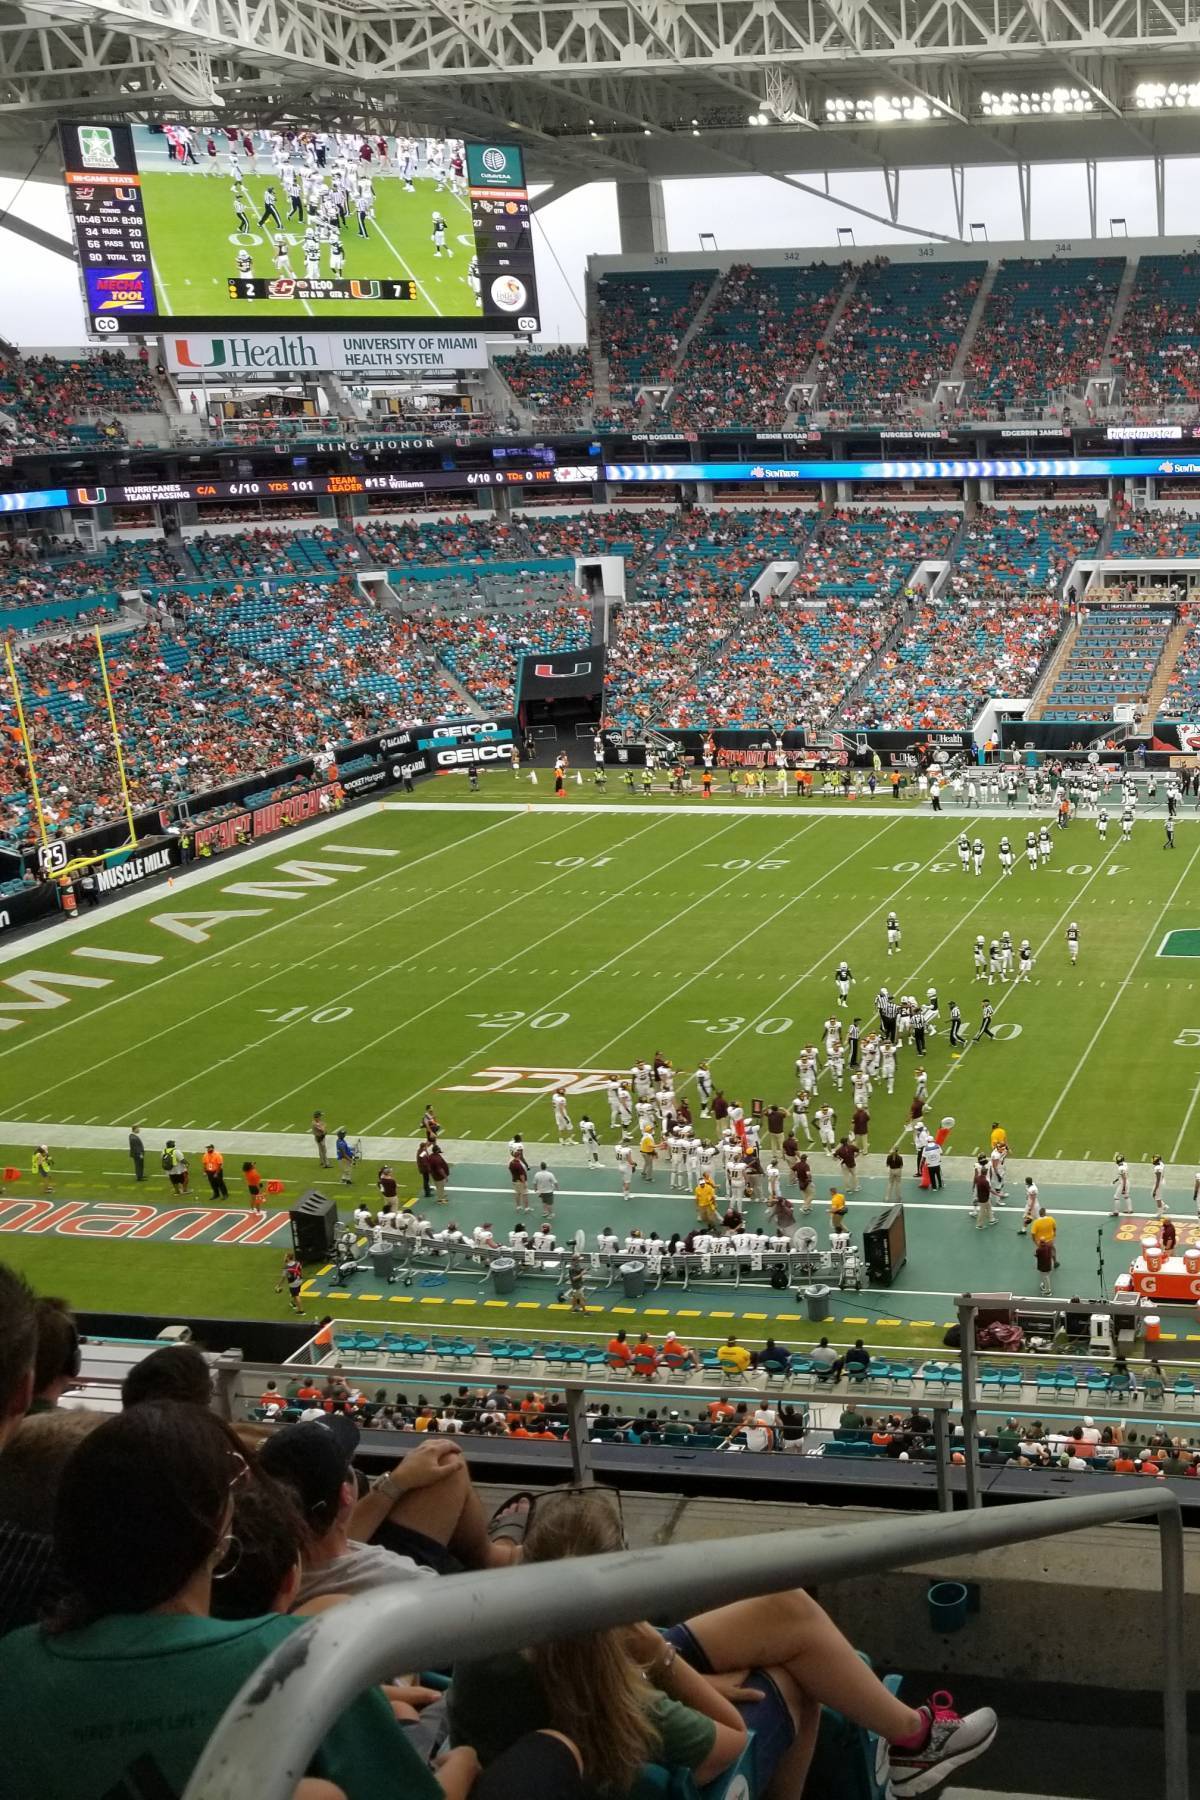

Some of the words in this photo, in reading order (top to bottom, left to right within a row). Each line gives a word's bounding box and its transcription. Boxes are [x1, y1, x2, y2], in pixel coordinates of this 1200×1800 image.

[84, 203, 91, 211] 7
[128, 203, 135, 212] 4
[473, 219, 482, 227] 27
[86, 228, 98, 236] 34
[1055, 244, 1071, 252] 344
[89, 253, 102, 261] 90
[784, 253, 799, 261] 342
[112, 291, 144, 300] TOOL
[246, 284, 255, 296] 2
[393, 285, 402, 297] 7
[98, 318, 116, 329] CC
[520, 320, 535, 329] CC
[343, 338, 407, 350] UNIVERSITY
[412, 338, 432, 349] OF
[437, 337, 478, 349] MIAMI
[345, 353, 391, 365] HEALTH
[396, 352, 444, 364] SYSTEM
[317, 442, 358, 452] RING
[375, 439, 435, 450] HONOR
[330, 477, 356, 485] TEAM
[467, 473, 490, 483] 6/10
[496, 473, 503, 482] 0
[507, 472, 523, 481] TDs
[525, 471, 533, 481] 0
[536, 471, 550, 480] INT
[197, 486, 216, 495] C/A
[229, 484, 259, 494] 6/10
[268, 482, 288, 491] YDS
[365, 478, 386, 488] #15
[389, 481, 424, 489] Williams
[124, 484, 181, 494] HURRICANES
[125, 493, 150, 501] TEAM
[152, 491, 190, 500] PASSING
[433, 722, 498, 739] GEICO
[364, 771, 386, 786] Mortgage
[97, 859, 144, 892] MUSCLE
[144, 849, 170, 872] MILK
[270, 1006, 354, 1023] 10
[478, 1011, 572, 1029] 20
[703, 1016, 795, 1035] 30
[1141, 1277, 1157, 1292] G
